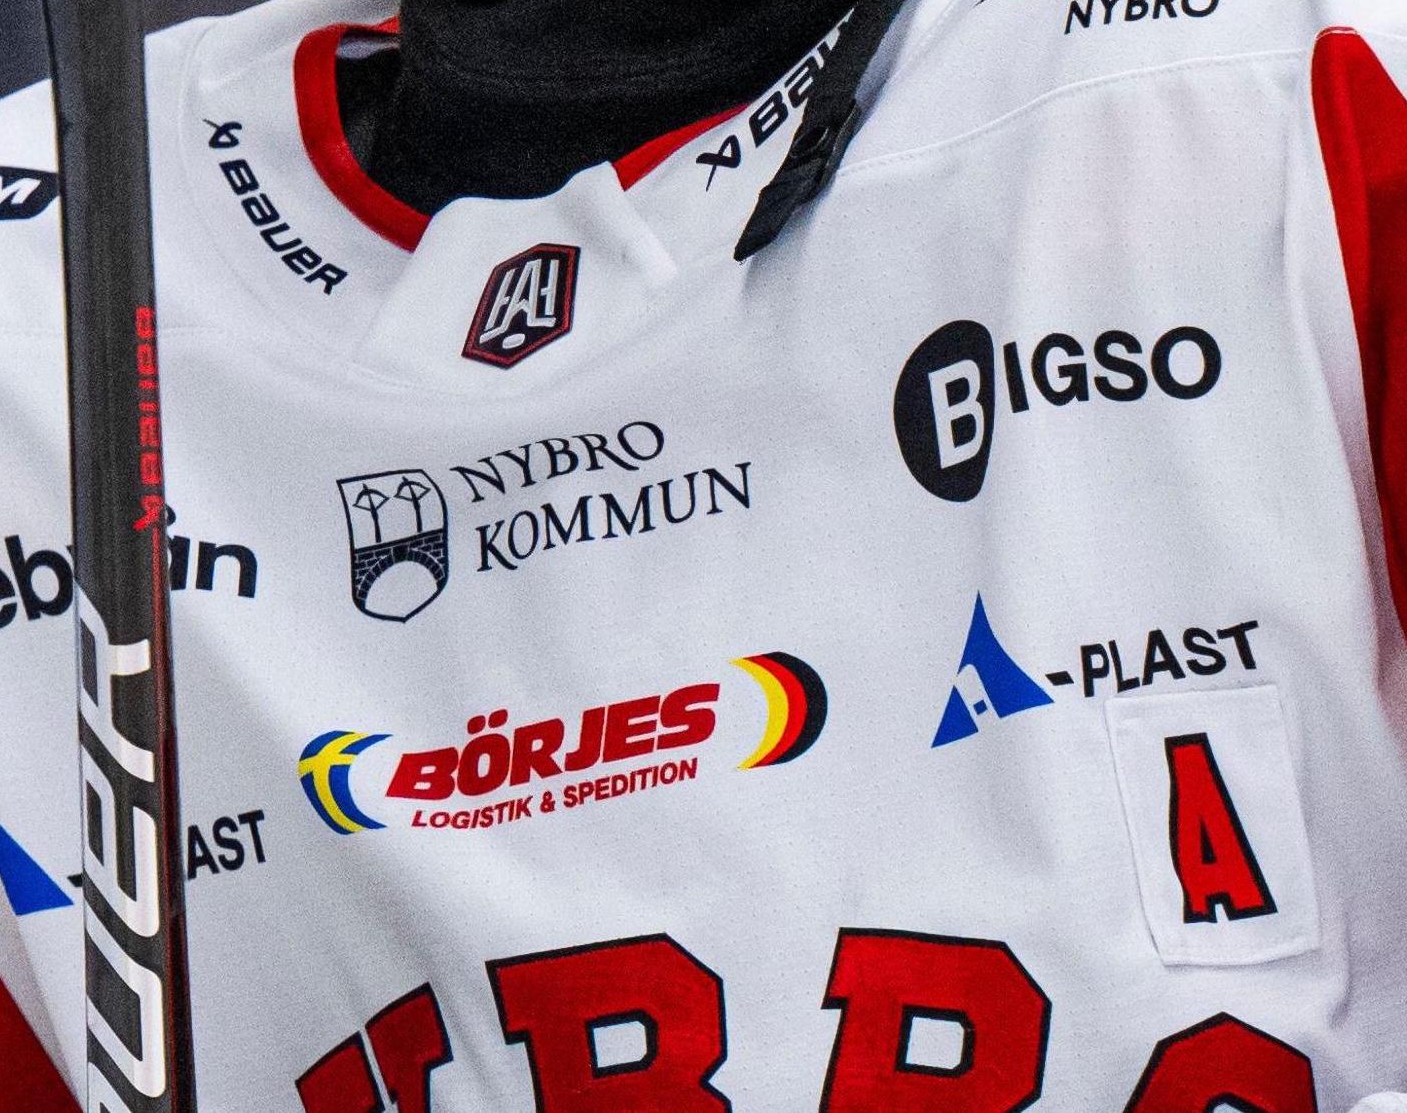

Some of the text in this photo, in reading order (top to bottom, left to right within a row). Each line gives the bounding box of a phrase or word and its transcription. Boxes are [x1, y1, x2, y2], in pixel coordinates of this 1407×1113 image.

[928, 326, 1222, 469] BIGSO
[450, 420, 665, 502] NYBRO
[475, 462, 752, 571] KOMMUN
[385, 683, 720, 801] BÖRJES
[411, 758, 698, 829] LOGISTIK & SPEDITION
[1164, 732, 1278, 924] A
